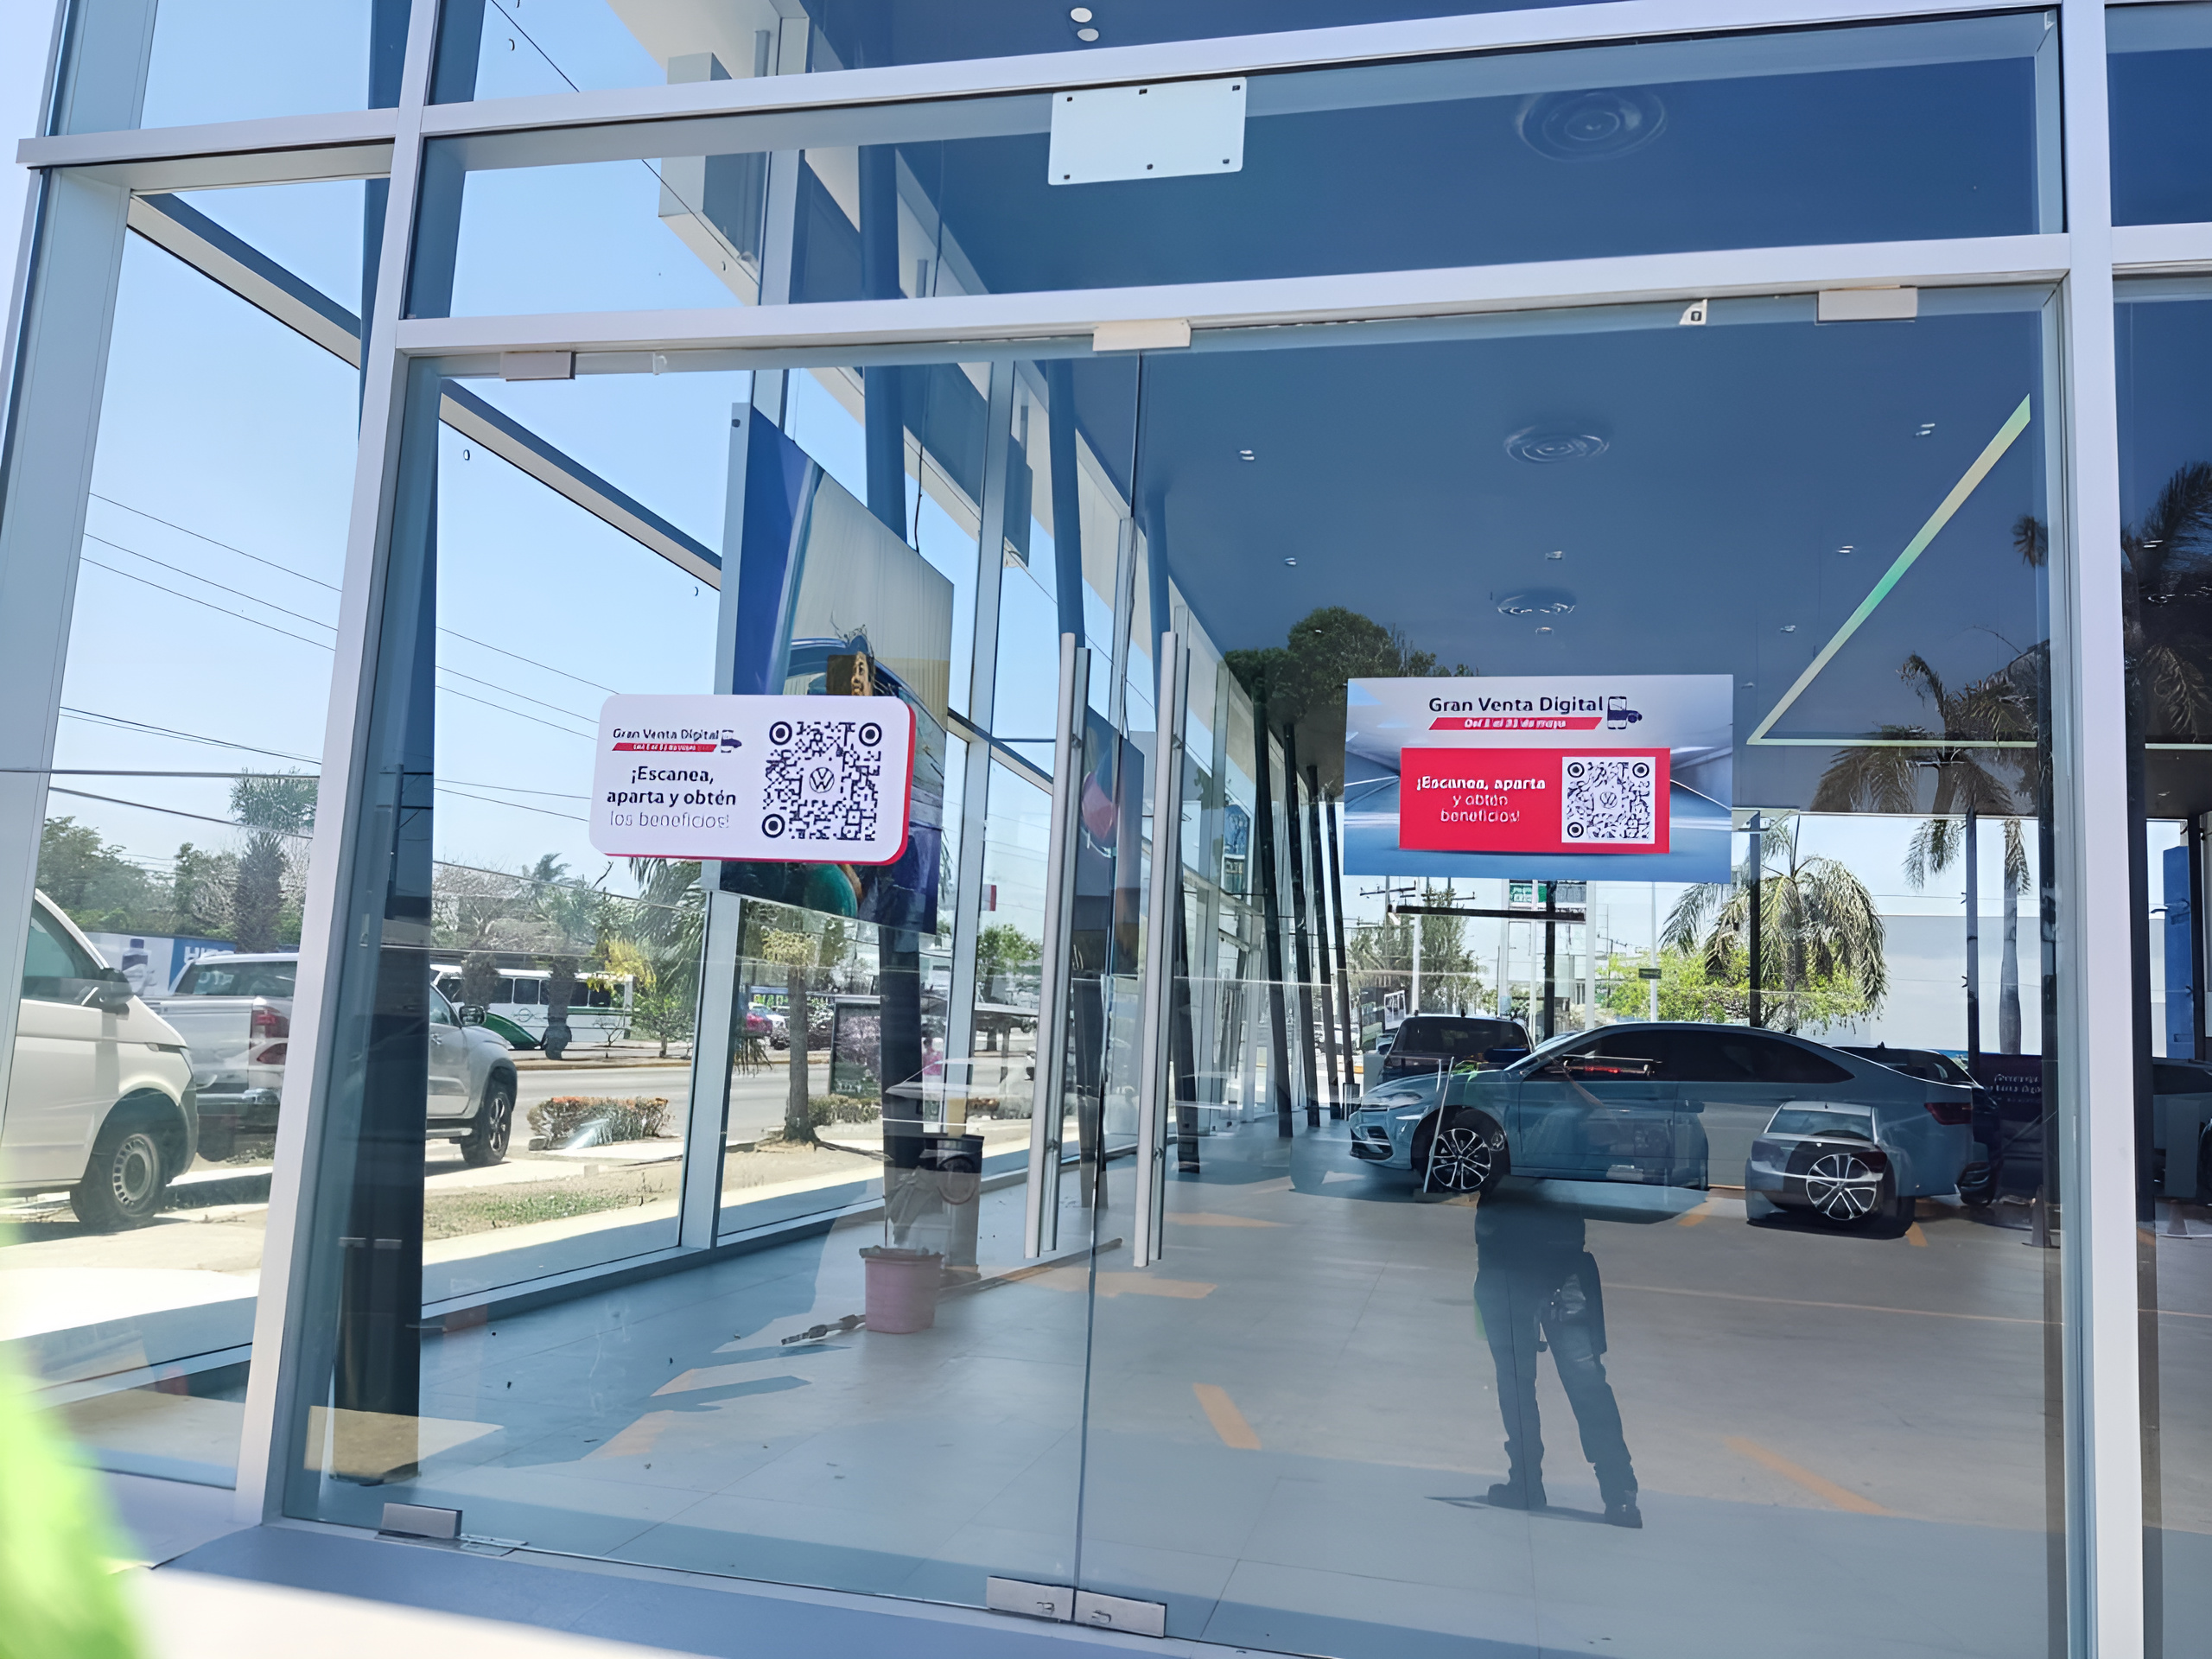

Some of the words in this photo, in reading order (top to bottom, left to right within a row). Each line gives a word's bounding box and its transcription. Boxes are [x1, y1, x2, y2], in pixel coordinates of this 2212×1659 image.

[1429, 696, 1473, 712] Gran
[1478, 696, 1533, 712] Venta
[1540, 696, 1604, 715] Digital
[613, 728, 640, 739] Gran
[643, 728, 677, 739] Venta
[681, 729, 720, 741] Digital
[632, 766, 714, 785] ¡Escanea,
[1494, 778, 1547, 791] aparta
[607, 791, 664, 807] aparta
[669, 792, 680, 808] y
[683, 789, 736, 806] obtén
[1452, 794, 1462, 808] y
[610, 810, 632, 827] los
